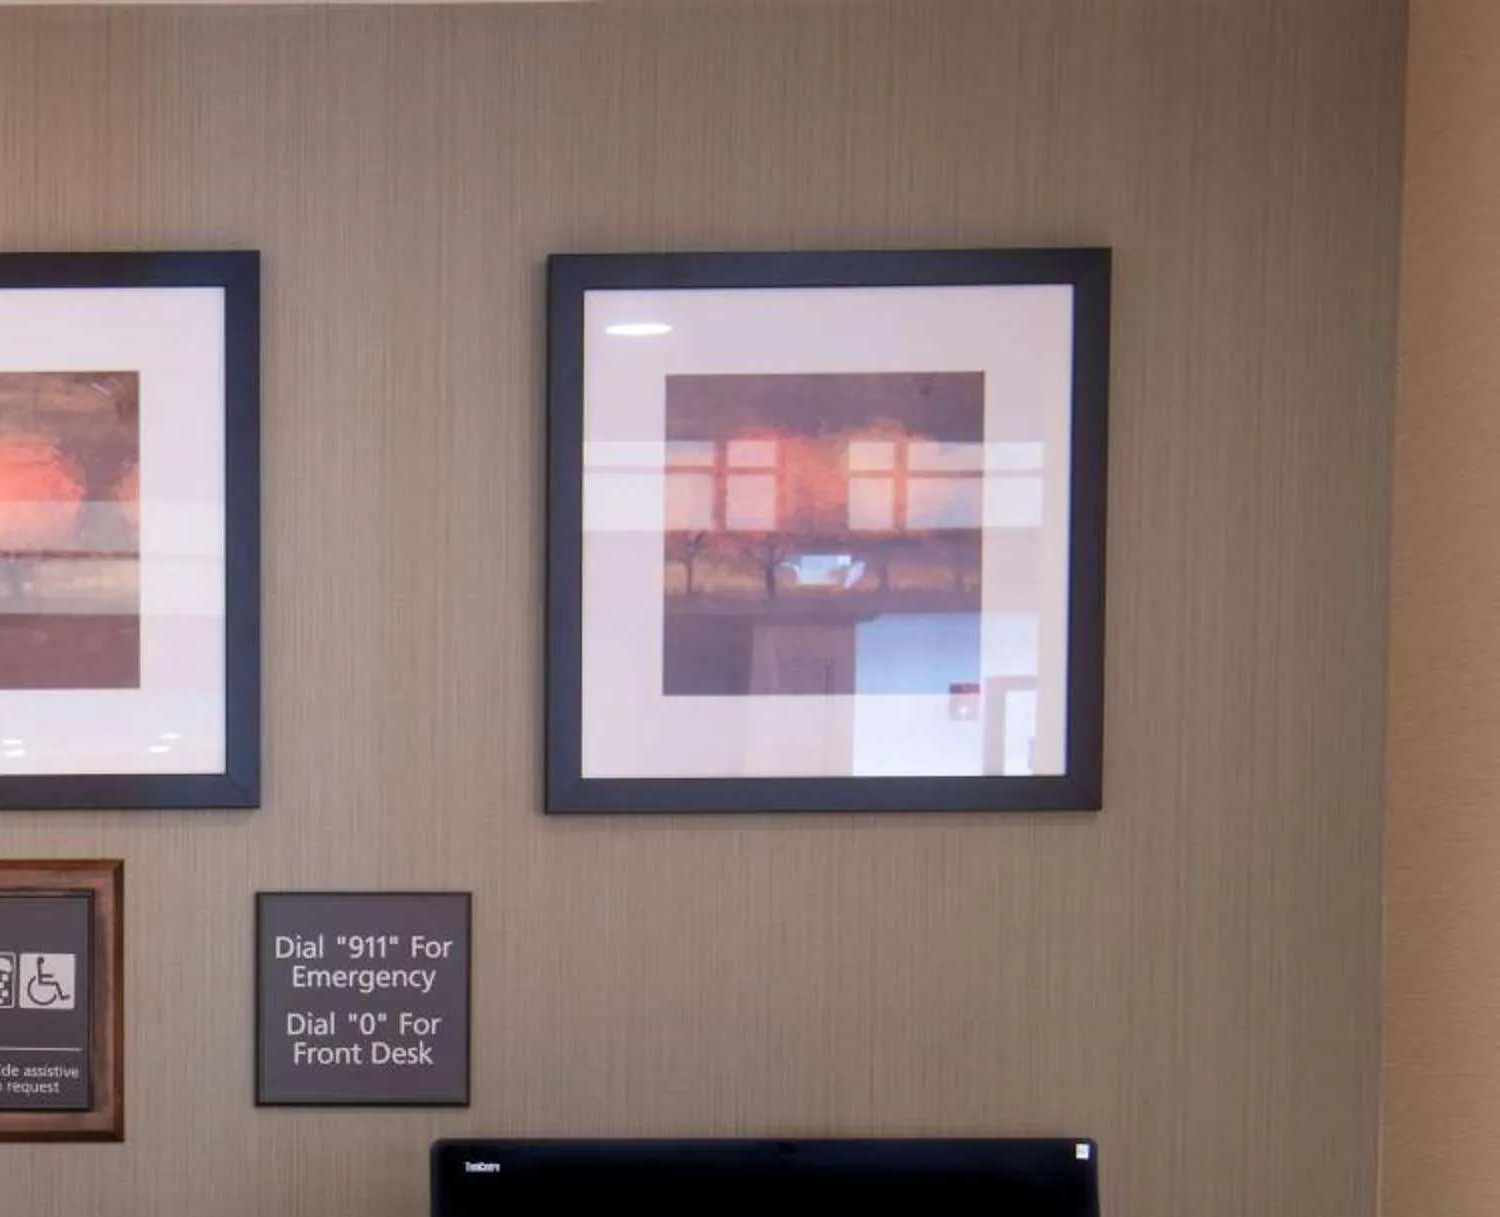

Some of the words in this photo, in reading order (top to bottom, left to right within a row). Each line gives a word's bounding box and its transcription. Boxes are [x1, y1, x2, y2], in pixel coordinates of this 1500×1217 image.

[275, 934, 324, 959] Dial
[336, 935, 399, 959] "911"
[410, 935, 453, 959] For
[292, 965, 437, 993] Emergency
[286, 1011, 336, 1036] Dial
[399, 1012, 443, 1036] For
[293, 1041, 363, 1065] Front
[371, 1040, 434, 1065] Desk
[23, 1065, 80, 1078] assistive
[7, 1081, 60, 1096] request
